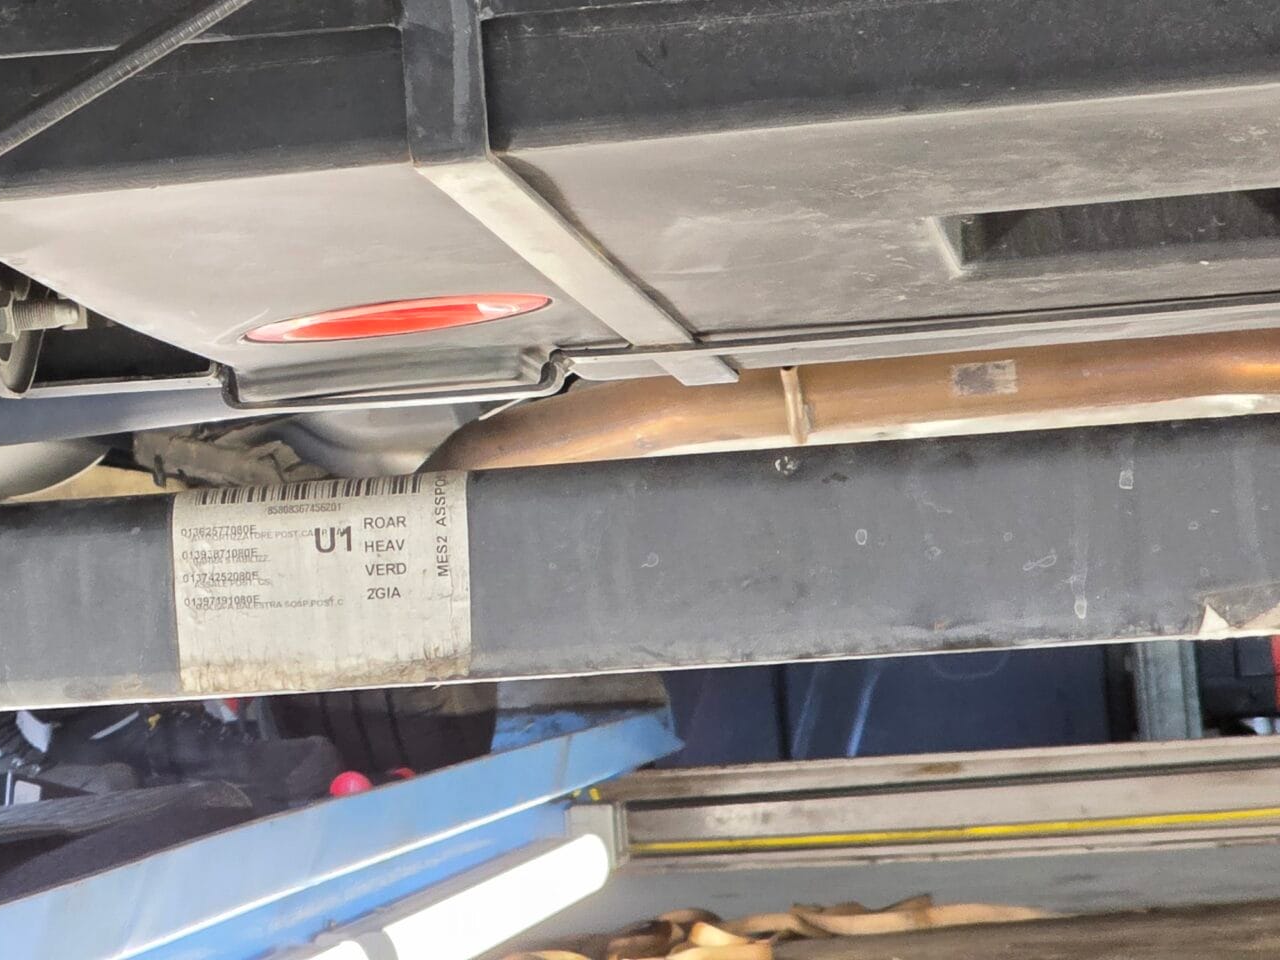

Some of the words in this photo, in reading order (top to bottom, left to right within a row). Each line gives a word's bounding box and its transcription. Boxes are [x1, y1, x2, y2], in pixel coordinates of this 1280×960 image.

[363, 515, 407, 529] ROAR
[314, 525, 352, 553] U1
[364, 538, 405, 553] HEAV
[436, 535, 449, 577] MES2
[365, 562, 407, 576] VERD
